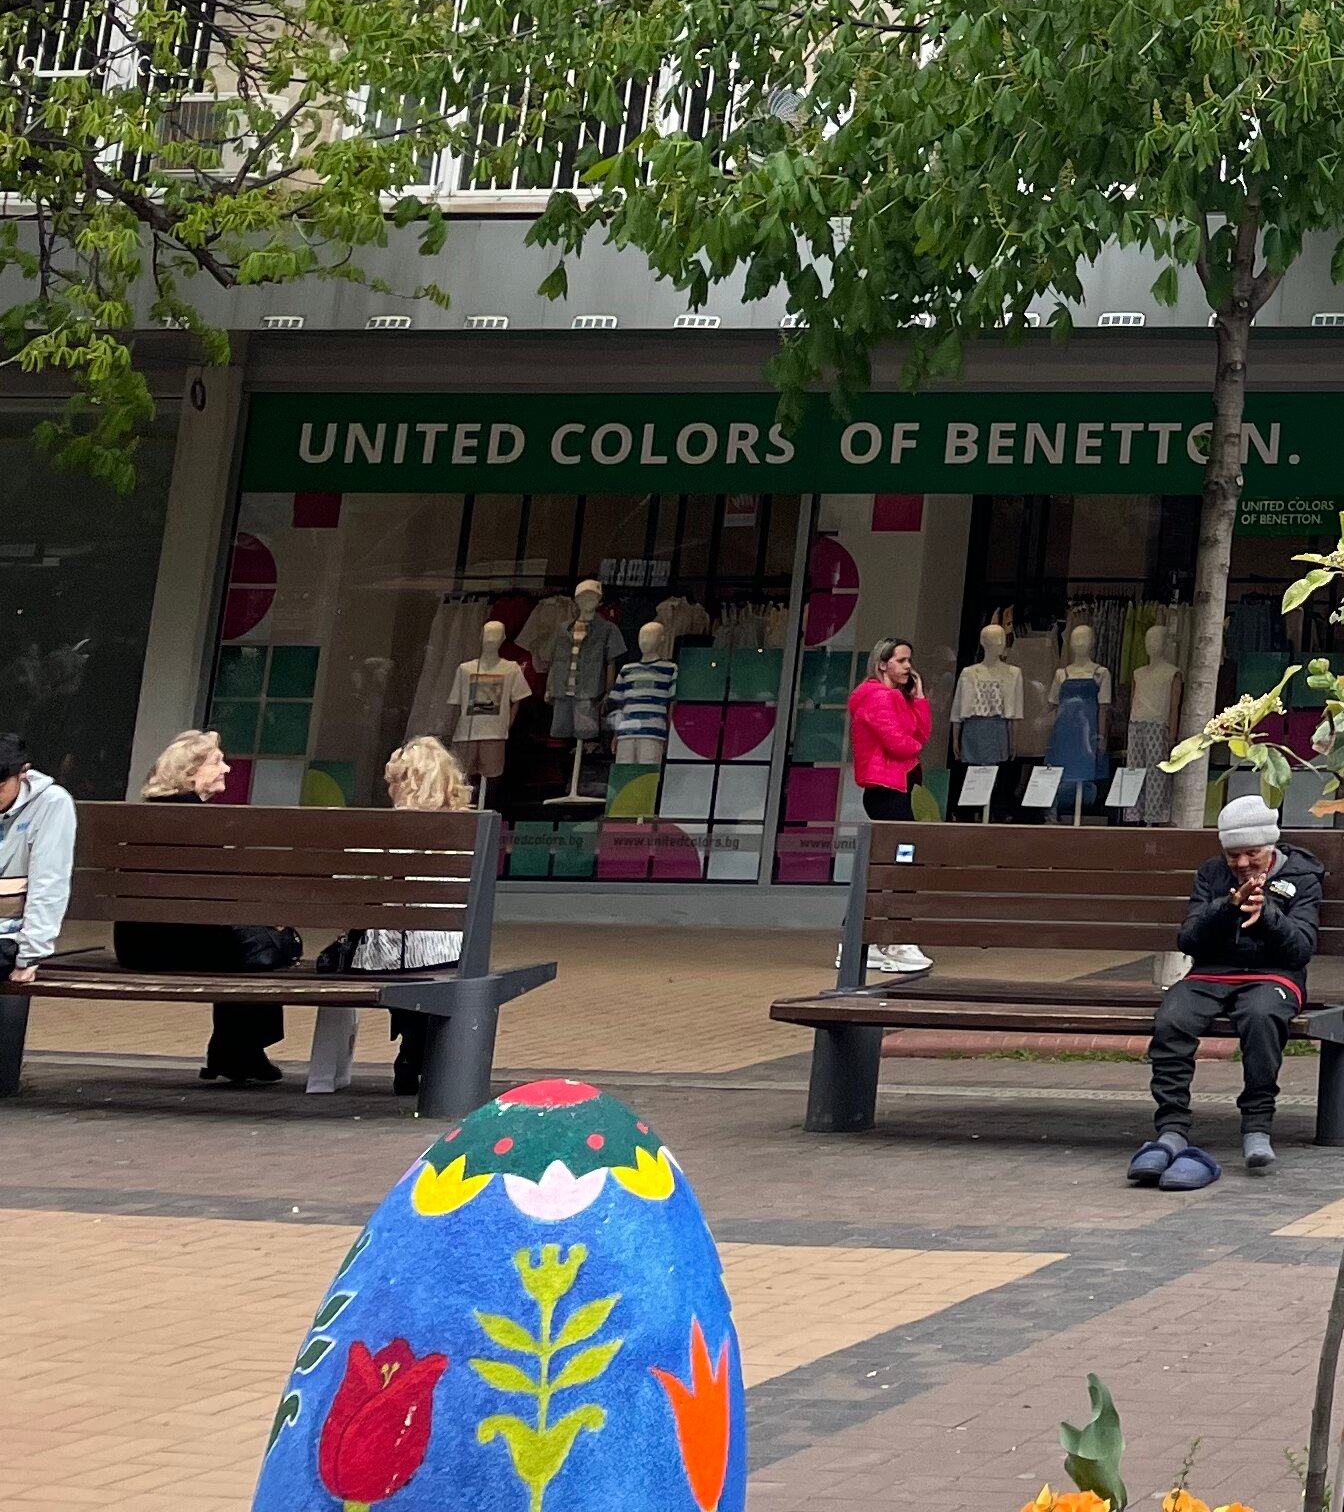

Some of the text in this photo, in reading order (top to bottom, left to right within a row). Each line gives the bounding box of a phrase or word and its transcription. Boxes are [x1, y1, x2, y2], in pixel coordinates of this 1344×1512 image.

[299, 422, 526, 464] UNITED
[550, 422, 795, 465] COLORS
[840, 421, 920, 465] OF
[1241, 500, 1335, 511] UNITED COLORS
[1241, 513, 1257, 525] OF
[613, 835, 740, 850] www.unitedcolors.bg
